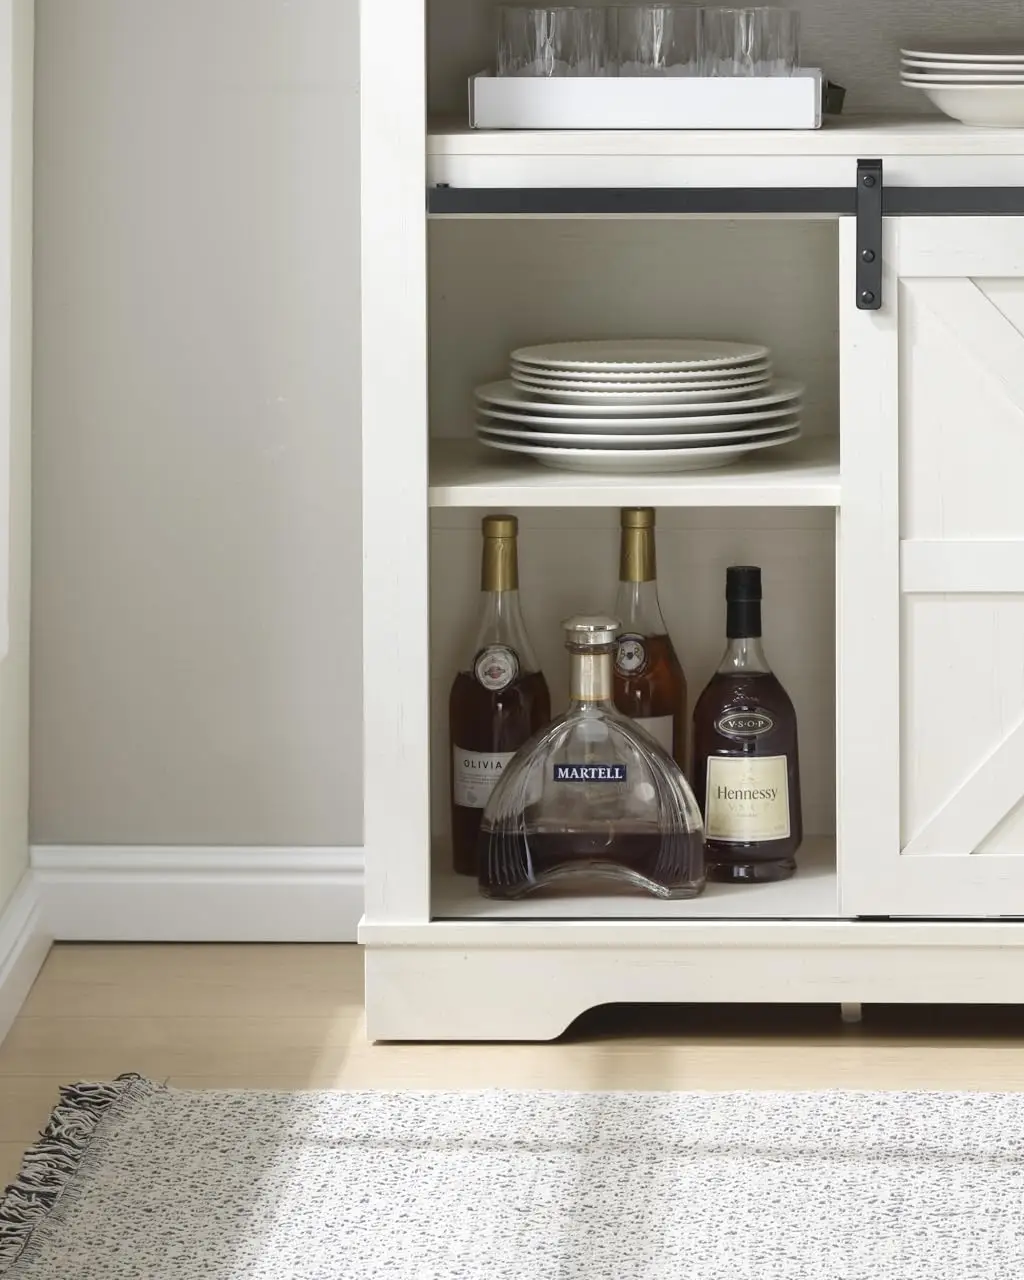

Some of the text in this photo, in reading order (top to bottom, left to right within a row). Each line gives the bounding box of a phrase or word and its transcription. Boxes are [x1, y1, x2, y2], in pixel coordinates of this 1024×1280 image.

[463, 759, 503, 769] OLIVIA
[557, 767, 623, 780] MARTELL
[717, 785, 779, 801] Hennessy
